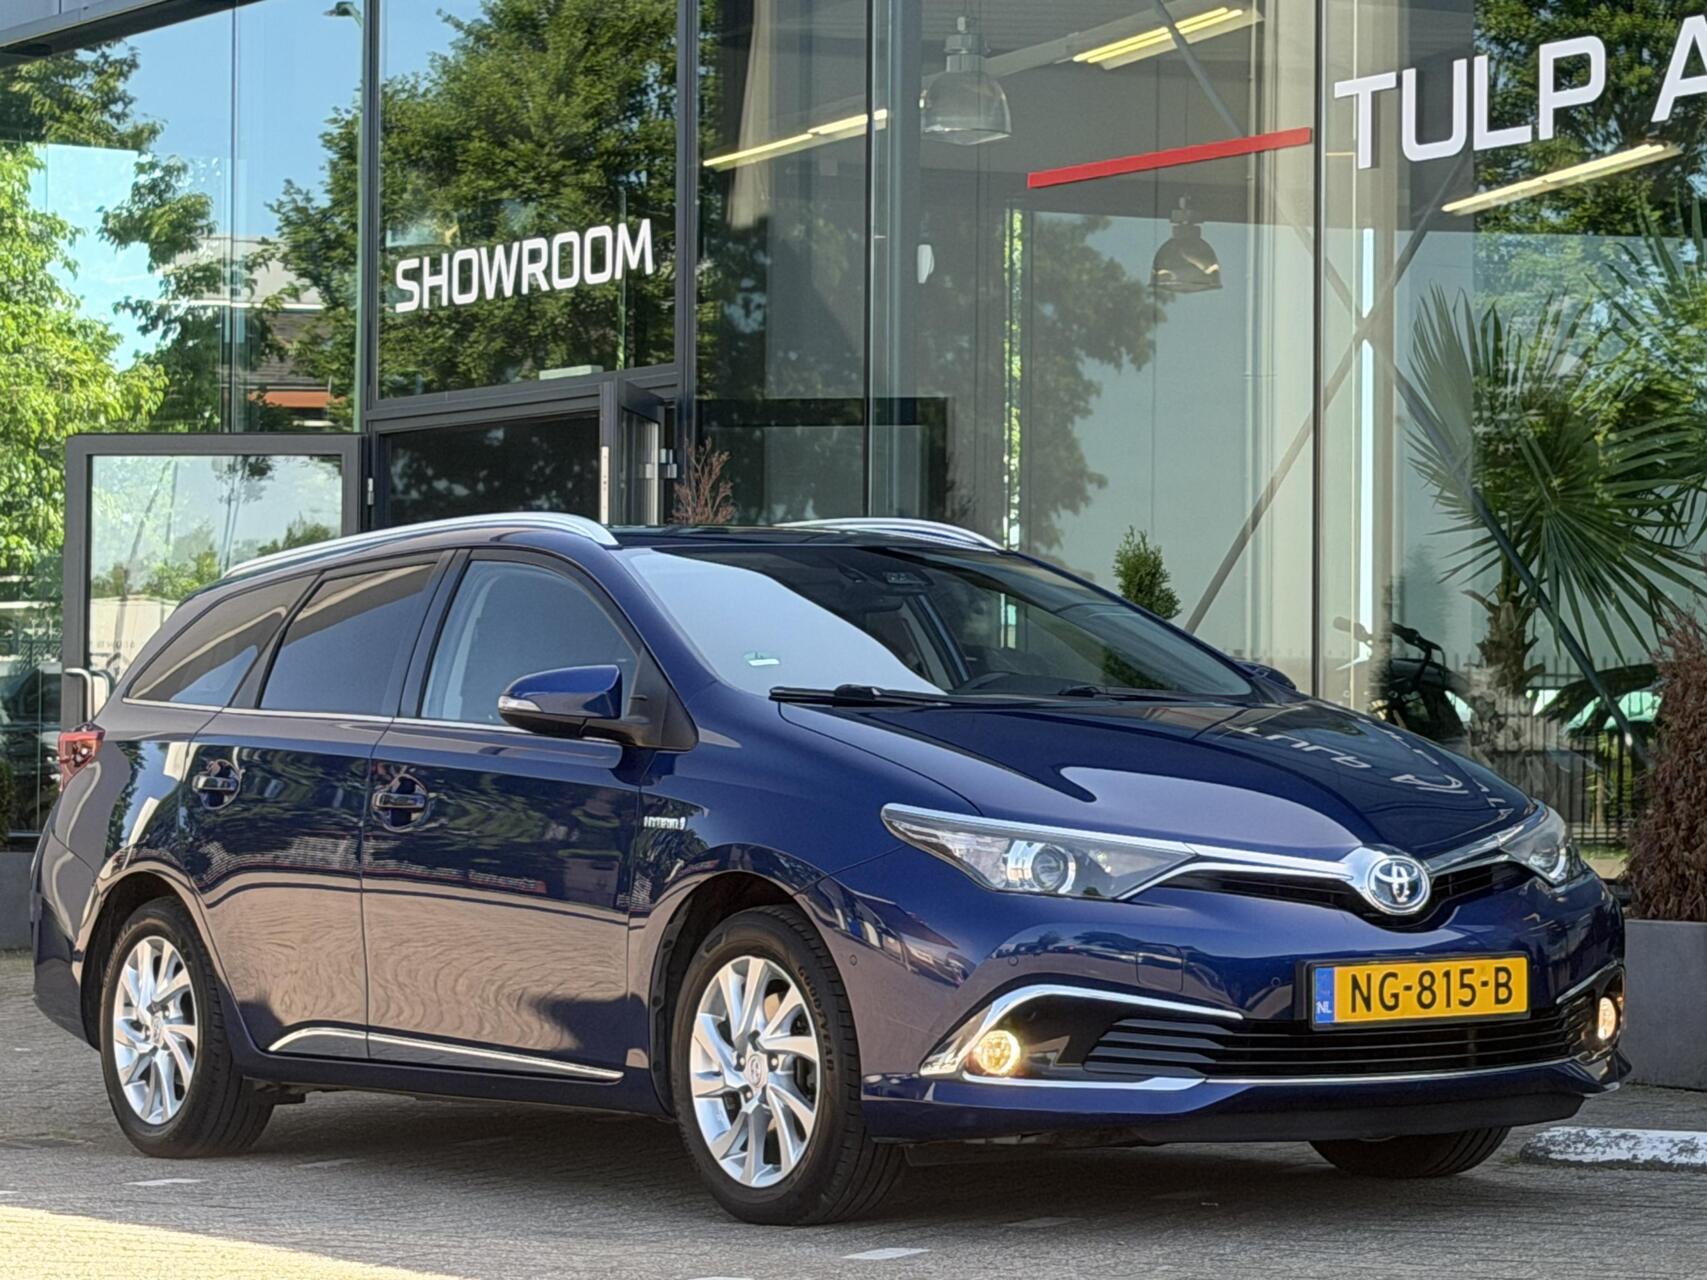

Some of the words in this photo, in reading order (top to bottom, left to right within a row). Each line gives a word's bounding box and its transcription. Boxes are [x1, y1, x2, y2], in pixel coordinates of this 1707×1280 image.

[1334, 35, 1606, 170] TULP
[1651, 14, 1707, 123] A
[395, 218, 654, 313] SHOWROOM
[1315, 1000, 1333, 1014] NL
[1350, 965, 1514, 1014] NG-815-B
